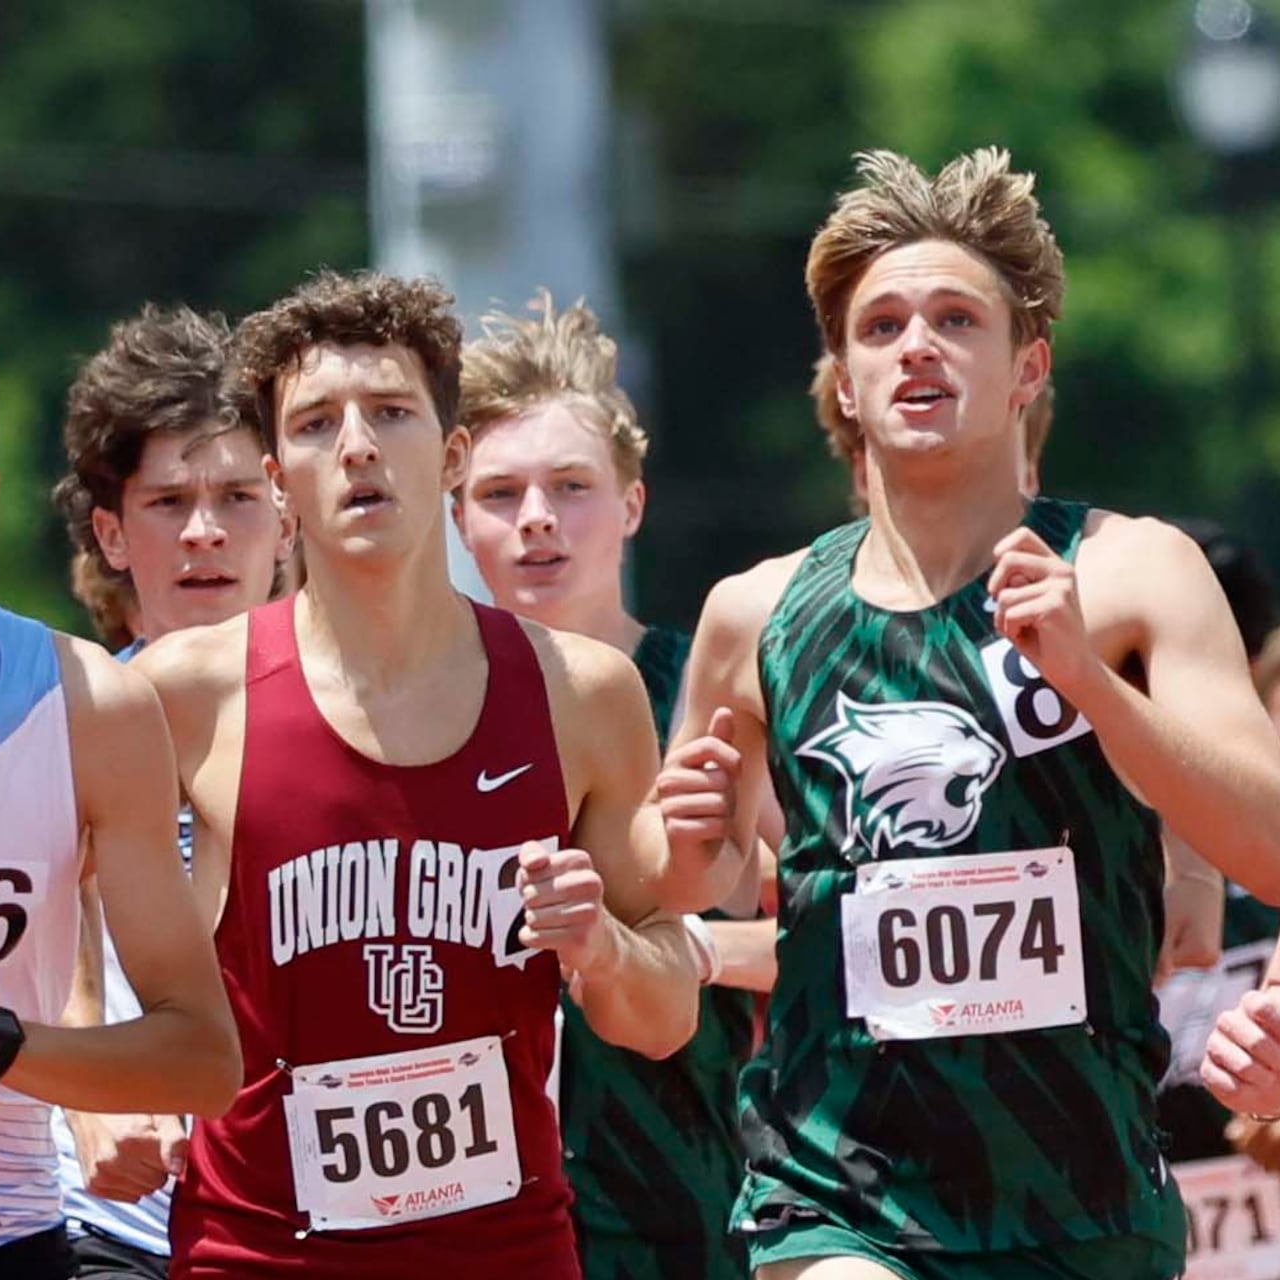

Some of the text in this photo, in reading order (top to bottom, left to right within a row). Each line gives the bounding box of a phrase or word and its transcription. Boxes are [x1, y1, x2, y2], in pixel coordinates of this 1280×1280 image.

[1003, 647, 1078, 739] 8
[268, 839, 398, 966] UNION
[408, 839, 495, 948] GRO
[878, 897, 1064, 987] 6074
[962, 1000, 1023, 1017] ATLANTA
[315, 1083, 497, 1182] 5681
[405, 1182, 464, 1205] ATLANTA
[1187, 1192, 1273, 1251] 71
